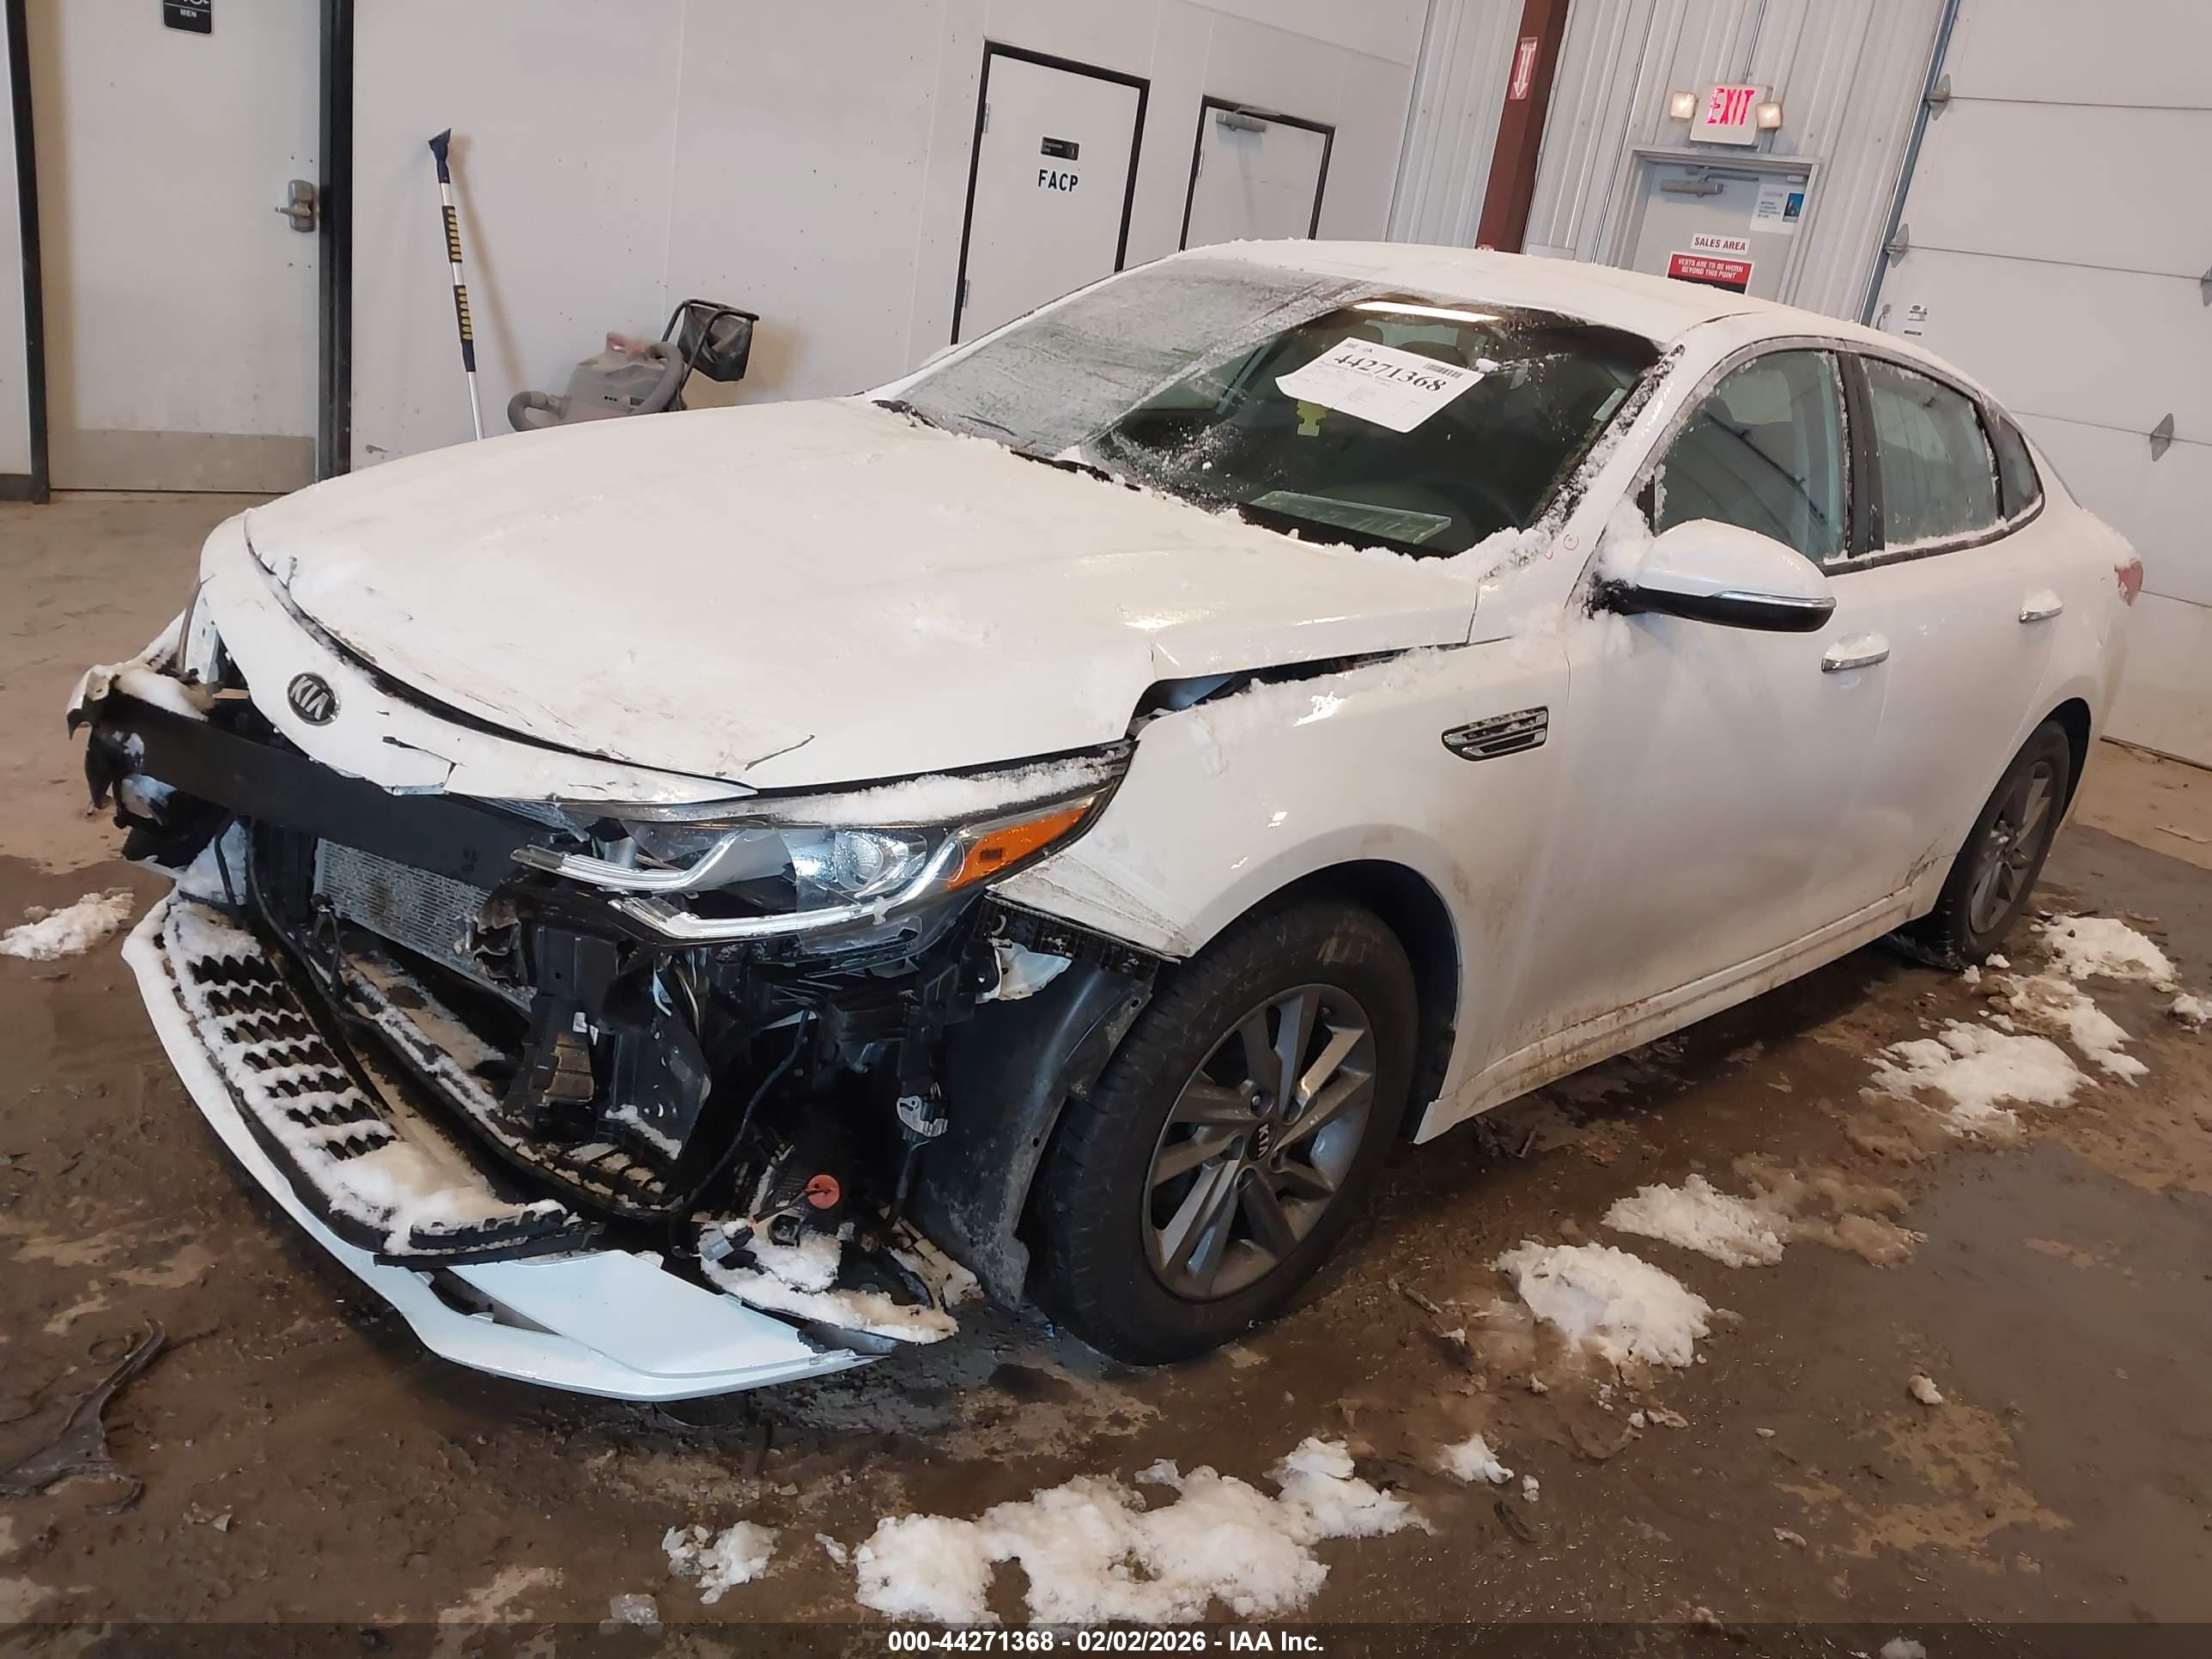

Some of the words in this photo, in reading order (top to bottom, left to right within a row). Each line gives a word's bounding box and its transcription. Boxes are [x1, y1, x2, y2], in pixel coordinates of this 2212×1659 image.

[1706, 88, 1755, 126] EXIT
[1037, 168, 1079, 192] FACP
[1694, 236, 1721, 248] SALES
[1723, 240, 1746, 252] AREA
[1678, 258, 1696, 266] VESTS
[1725, 264, 1744, 272] WORN
[1681, 265, 1705, 275] BEYOND
[1718, 270, 1736, 279] POINT
[1334, 354, 1447, 392] 44271368
[289, 675, 330, 720] KIA
[1258, 1122, 1269, 1158] KIA
